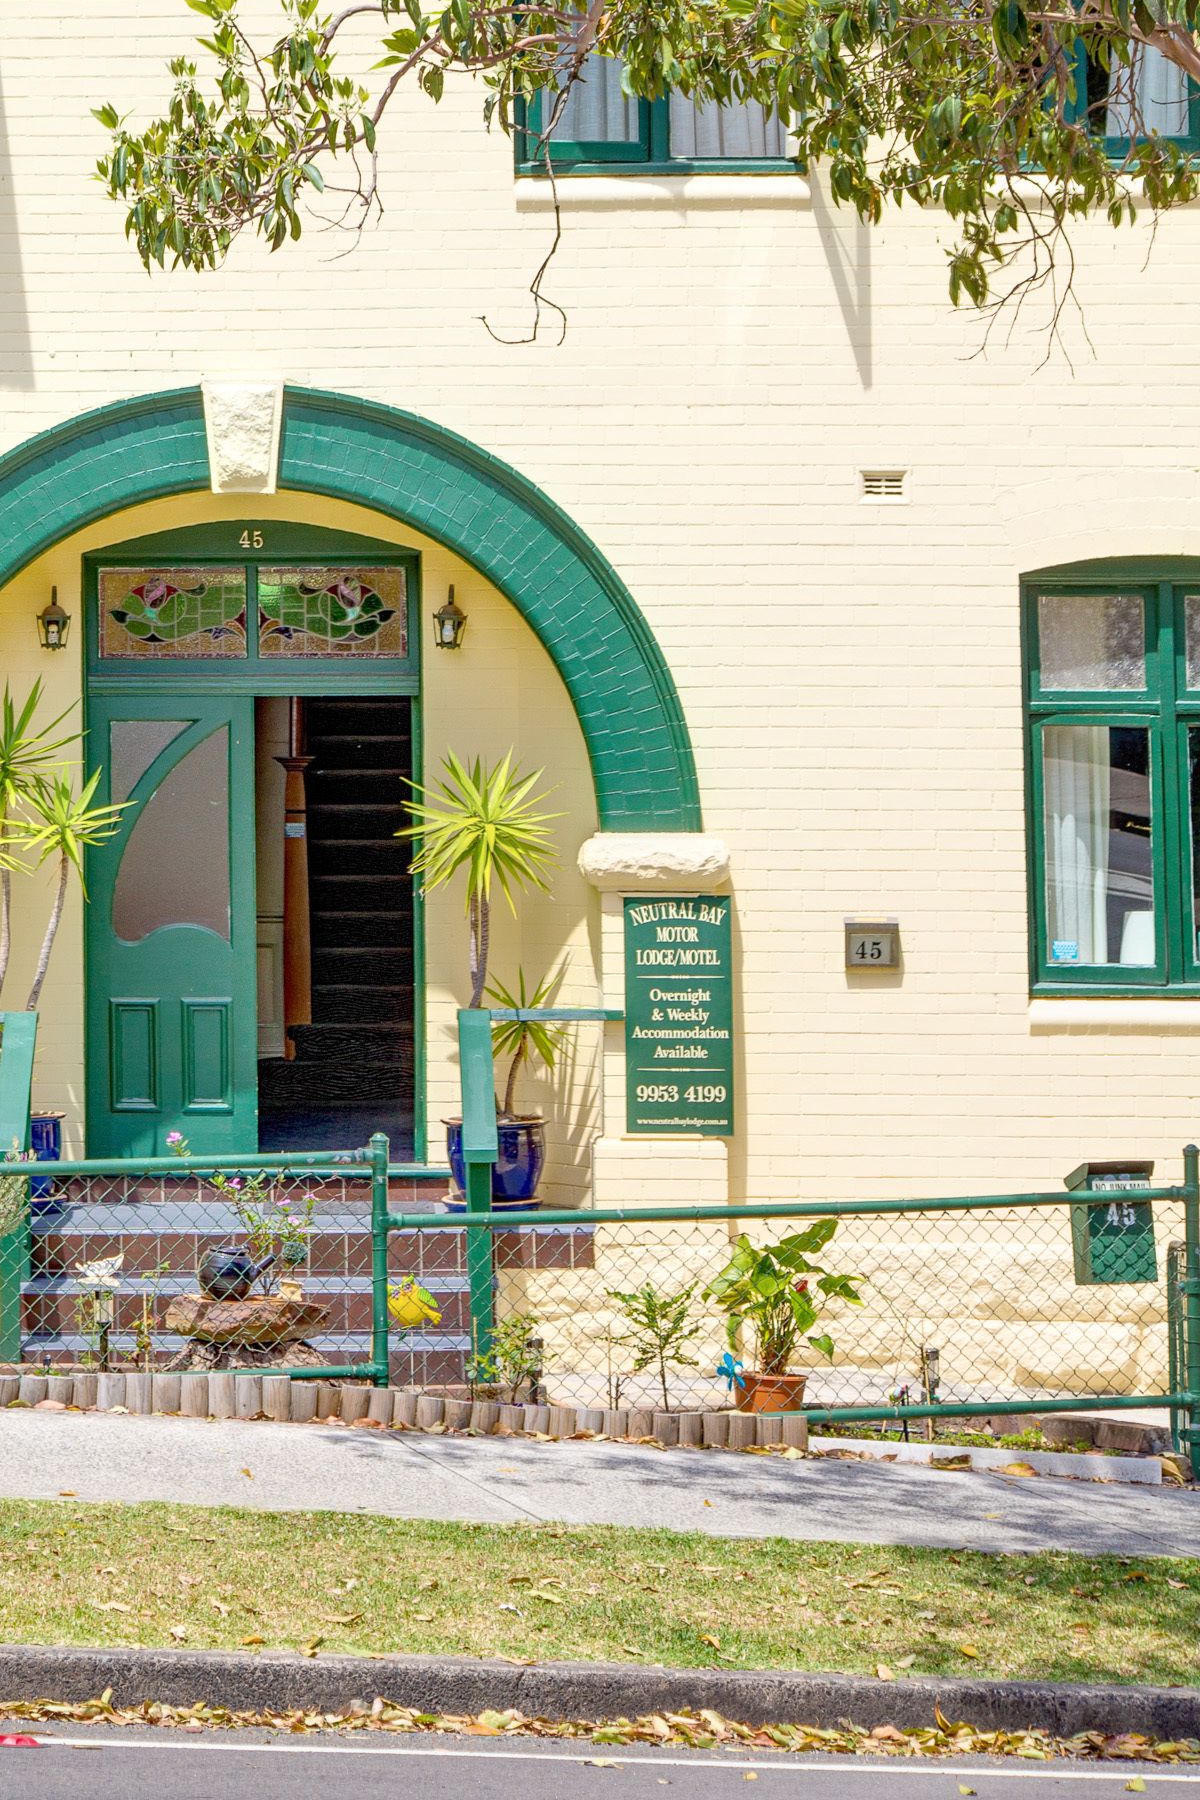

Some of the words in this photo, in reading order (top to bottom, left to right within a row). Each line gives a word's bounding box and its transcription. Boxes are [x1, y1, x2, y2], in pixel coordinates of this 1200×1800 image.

[239, 530, 264, 548] 45
[629, 902, 697, 926] NEUTRAL
[698, 904, 727, 926] BAY
[656, 927, 699, 942] MOTOR
[636, 949, 721, 967] LODGE/MOTEL
[855, 940, 882, 960] 45
[649, 988, 711, 1006] Overnight
[651, 1008, 664, 1021] &
[667, 1008, 710, 1025] Weekly
[632, 1026, 730, 1039] Accommodation
[653, 1045, 709, 1059] Available
[636, 1085, 679, 1102] 9953
[683, 1085, 727, 1103] 4199
[1106, 1202, 1136, 1226] 45
